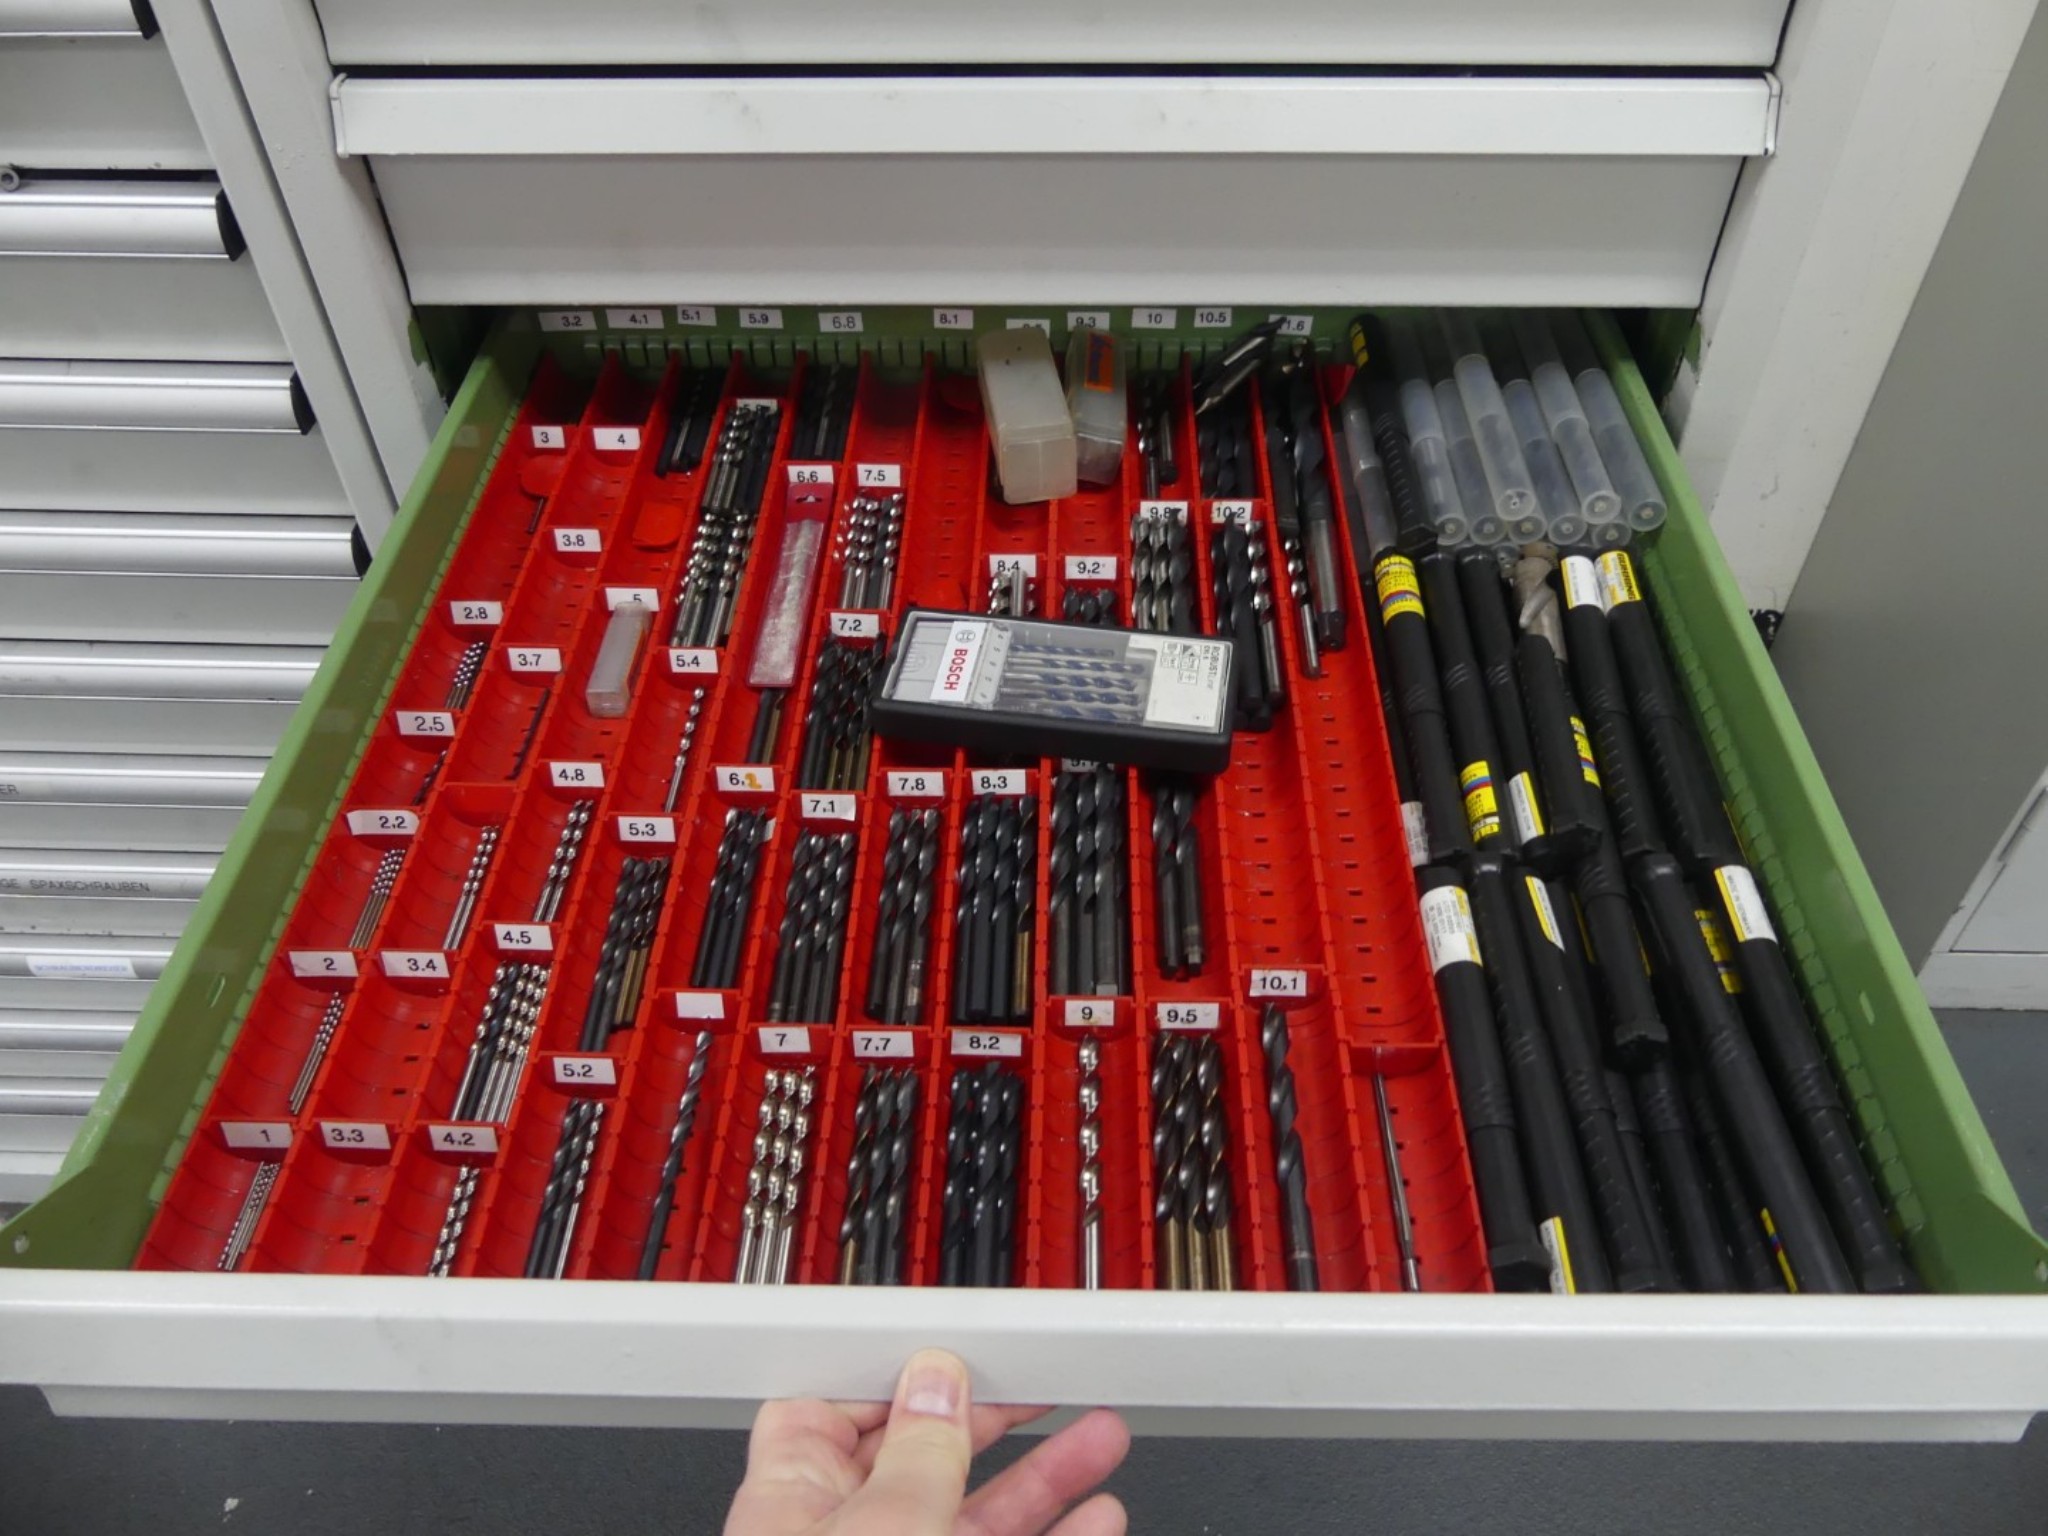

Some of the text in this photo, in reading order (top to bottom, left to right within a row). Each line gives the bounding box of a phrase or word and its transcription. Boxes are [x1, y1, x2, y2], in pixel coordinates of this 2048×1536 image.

[1148, 313, 1162, 324] 10
[541, 432, 549, 443] 3
[617, 434, 626, 444] 4
[944, 648, 968, 690] BOSCH
[323, 957, 337, 971] 2
[1081, 1006, 1093, 1021] 9
[775, 1033, 787, 1047] 7
[260, 1129, 270, 1142] 1
